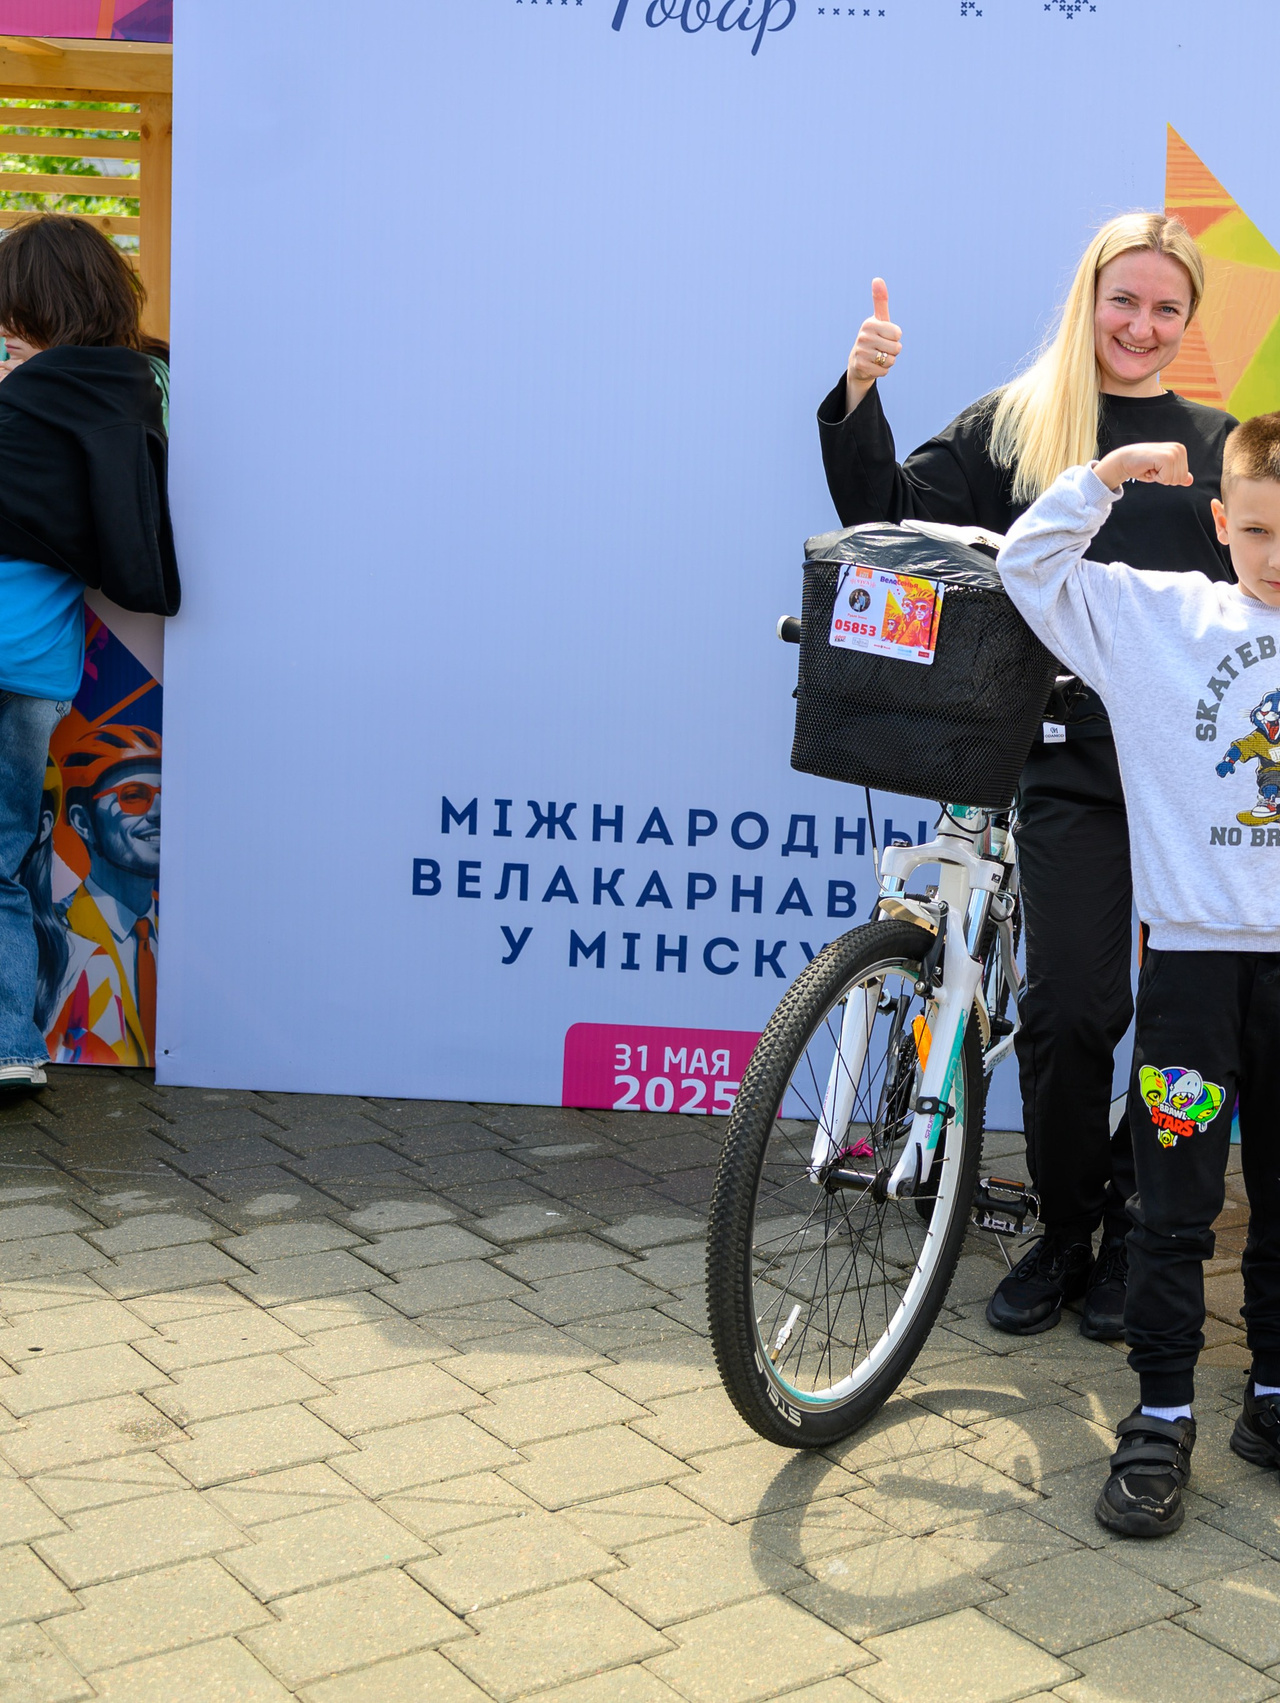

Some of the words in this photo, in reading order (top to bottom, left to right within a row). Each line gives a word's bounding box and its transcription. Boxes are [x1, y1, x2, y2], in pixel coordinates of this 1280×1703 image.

[834, 618, 877, 637] 05853
[1210, 826, 1242, 846] NO
[411, 858, 876, 919] ВЕЛАКАРНАВ
[500, 925, 534, 965] У
[614, 1043, 648, 1072] 31
[663, 1046, 730, 1077] МАЯ
[612, 1074, 741, 1116] 2025
[1159, 1103, 1188, 1120] BRAWL
[1151, 1105, 1196, 1138] STARS
